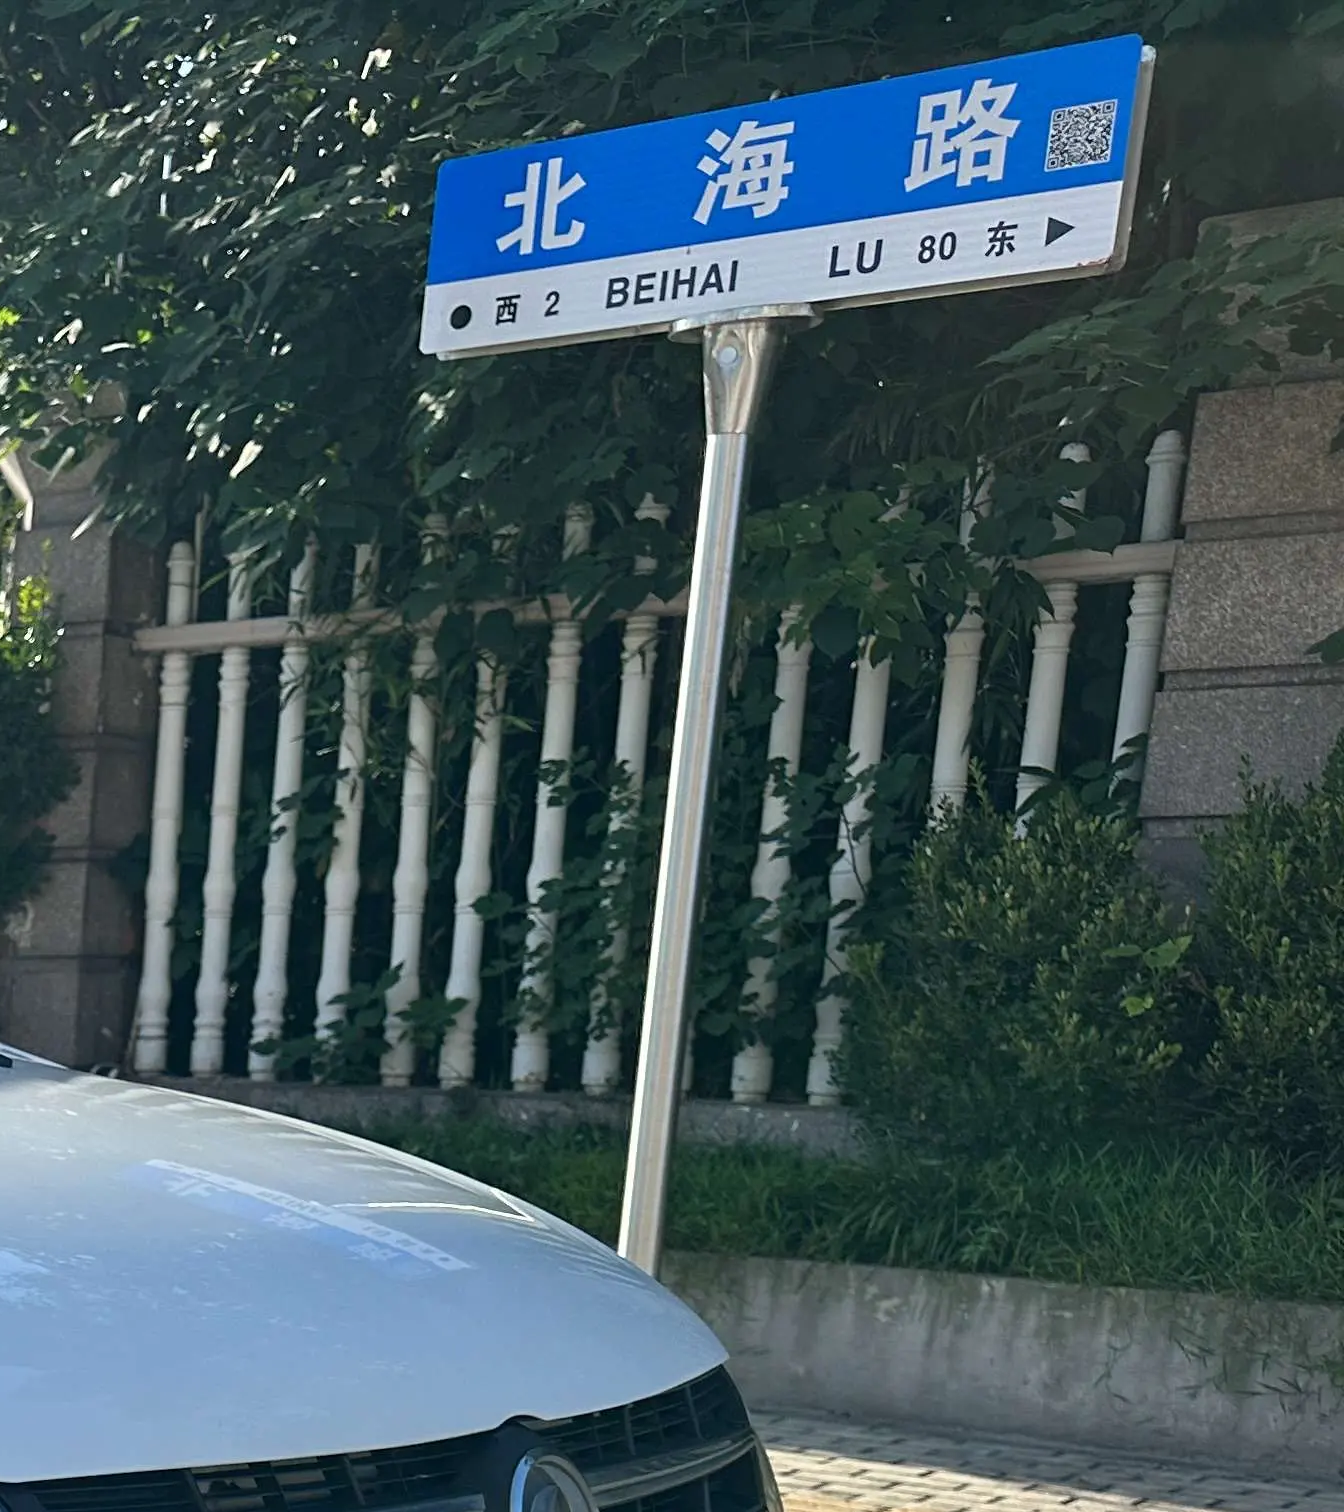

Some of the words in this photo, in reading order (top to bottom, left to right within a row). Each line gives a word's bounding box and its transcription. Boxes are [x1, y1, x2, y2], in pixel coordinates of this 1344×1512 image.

[495, 78, 1021, 257] 北海路
[495, 294, 521, 325] 西
[544, 290, 561, 317] 2
[605, 260, 739, 309] BEIHAI
[828, 239, 884, 278] LU
[918, 231, 957, 264] 80
[985, 220, 1018, 257] 东
